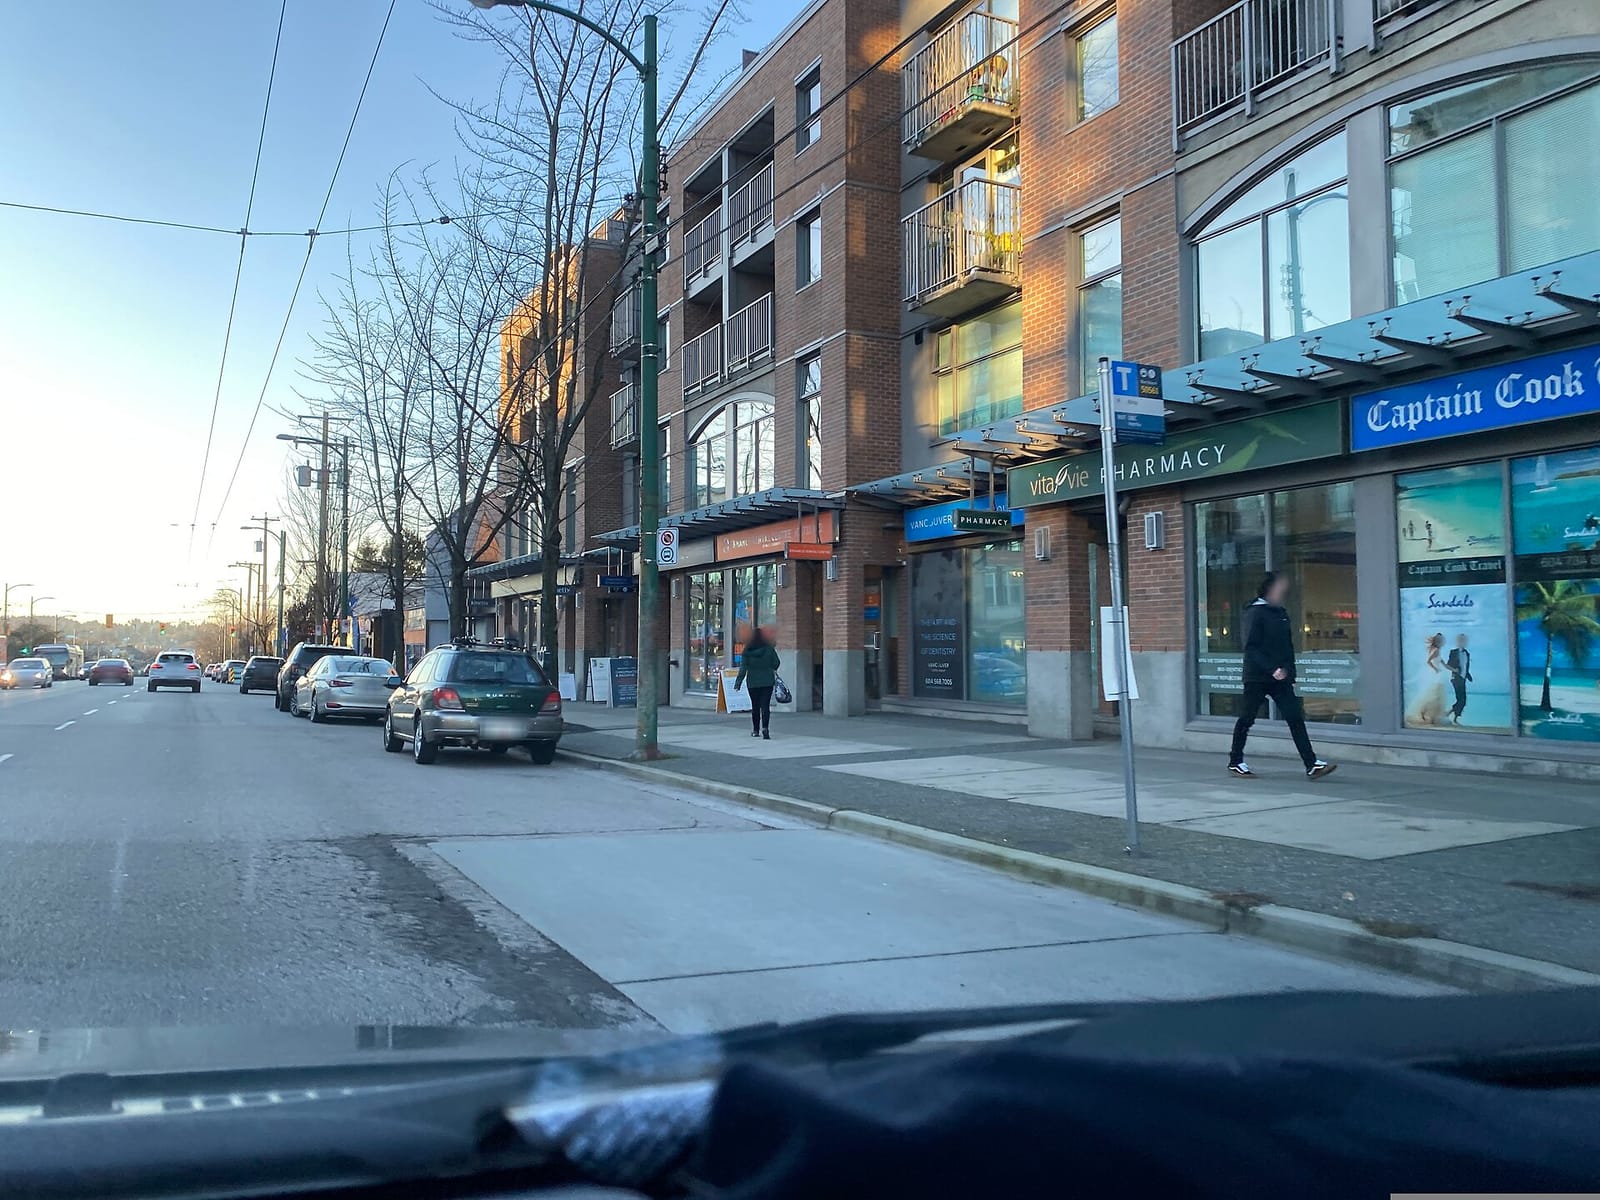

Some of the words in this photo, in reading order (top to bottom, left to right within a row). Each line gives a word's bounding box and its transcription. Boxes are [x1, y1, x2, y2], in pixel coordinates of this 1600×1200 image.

[1116, 366, 1132, 391] T
[1367, 383, 1483, 432] Captain
[1495, 361, 1585, 409] Cook
[960, 516, 1008, 527] PHARMACY
[1428, 593, 1474, 609] Sandals
[929, 647, 957, 656] DENTISTRY
